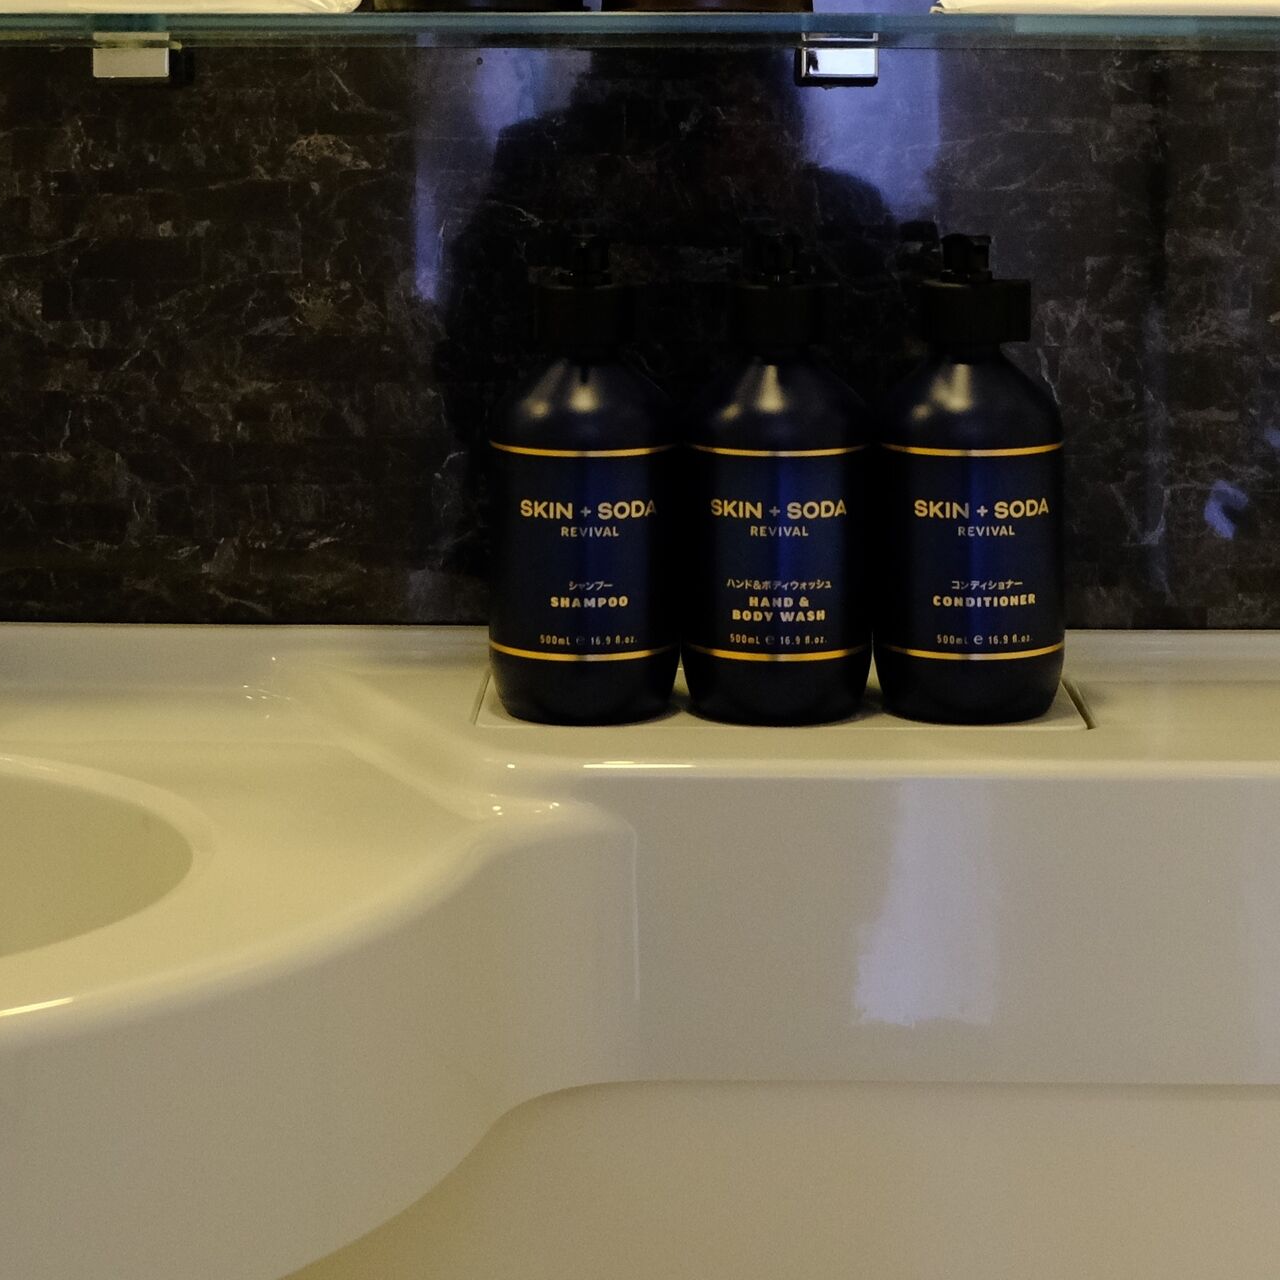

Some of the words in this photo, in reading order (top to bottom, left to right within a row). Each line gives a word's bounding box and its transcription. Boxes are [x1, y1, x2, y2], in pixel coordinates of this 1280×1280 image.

[520, 499, 573, 520] SKIN
[597, 499, 657, 520] SODA
[710, 498, 762, 519] SKIN
[787, 499, 847, 520] SODA
[914, 499, 970, 519] SKIN
[994, 497, 1049, 519] SODA
[561, 526, 619, 538] REVIVAL
[750, 526, 809, 537] REVIVAL
[958, 525, 1015, 537] REVIVAL
[951, 579, 1023, 591] コンディショナー
[550, 596, 629, 608] SHAMPOO
[748, 596, 794, 608] HAND
[932, 593, 1036, 608] CONDITIONER
[731, 609, 774, 622] BODY
[780, 609, 826, 622] WASH
